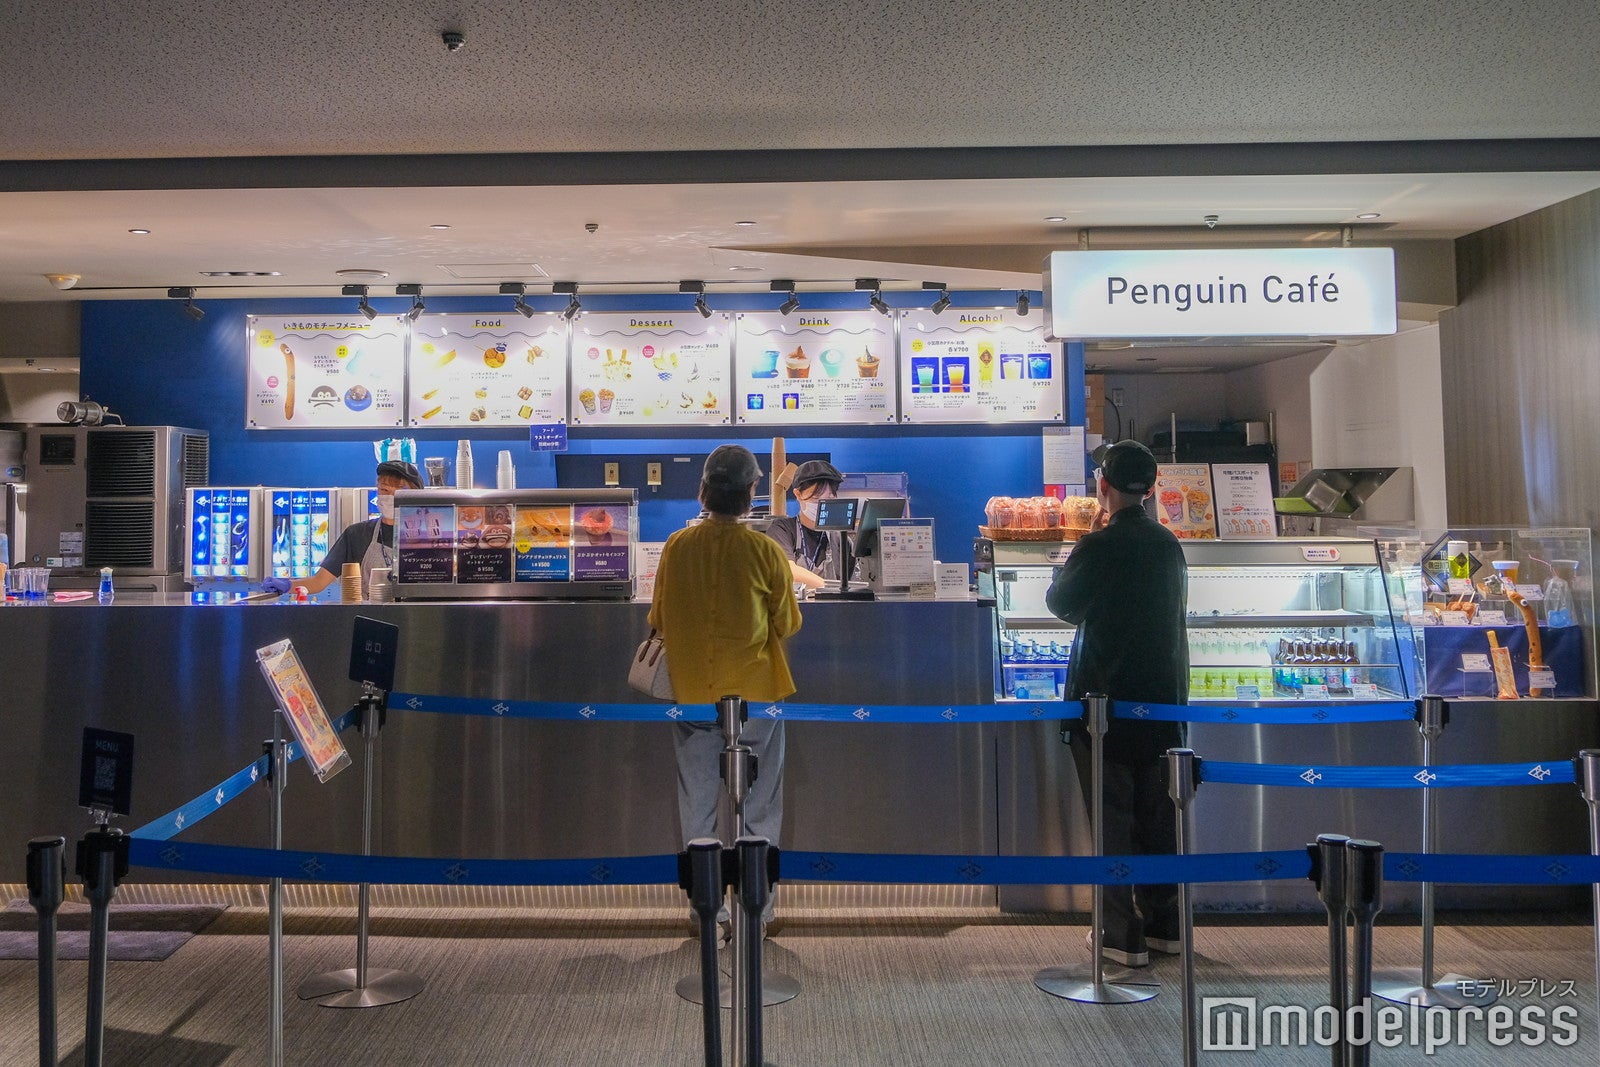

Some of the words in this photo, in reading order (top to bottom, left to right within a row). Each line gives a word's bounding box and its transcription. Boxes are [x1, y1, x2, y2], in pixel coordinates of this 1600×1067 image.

[1108, 276, 1247, 312] Penguin
[1263, 273, 1339, 303] Café
[960, 314, 1004, 322] Alcohol
[365, 640, 382, 653] 出口
[96, 740, 119, 752] MENU
